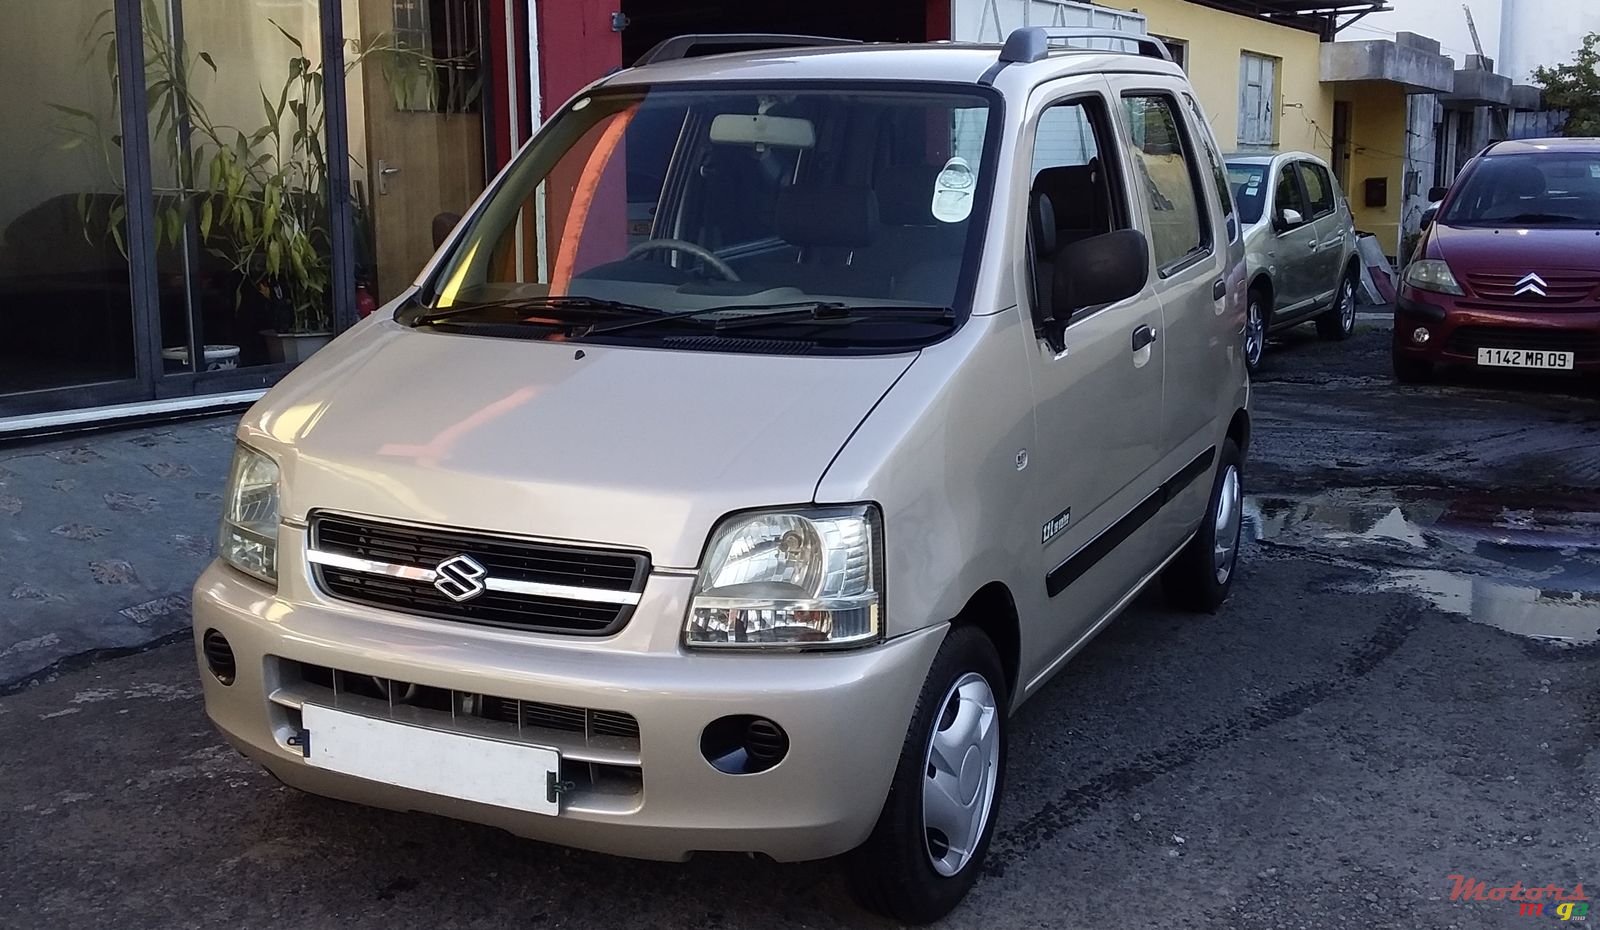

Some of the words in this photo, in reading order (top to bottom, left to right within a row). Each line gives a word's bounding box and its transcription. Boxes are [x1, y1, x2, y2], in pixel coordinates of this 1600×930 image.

[1486, 350, 1521, 365] 1142
[1525, 352, 1544, 366] MR
[1548, 353, 1567, 367] 09
